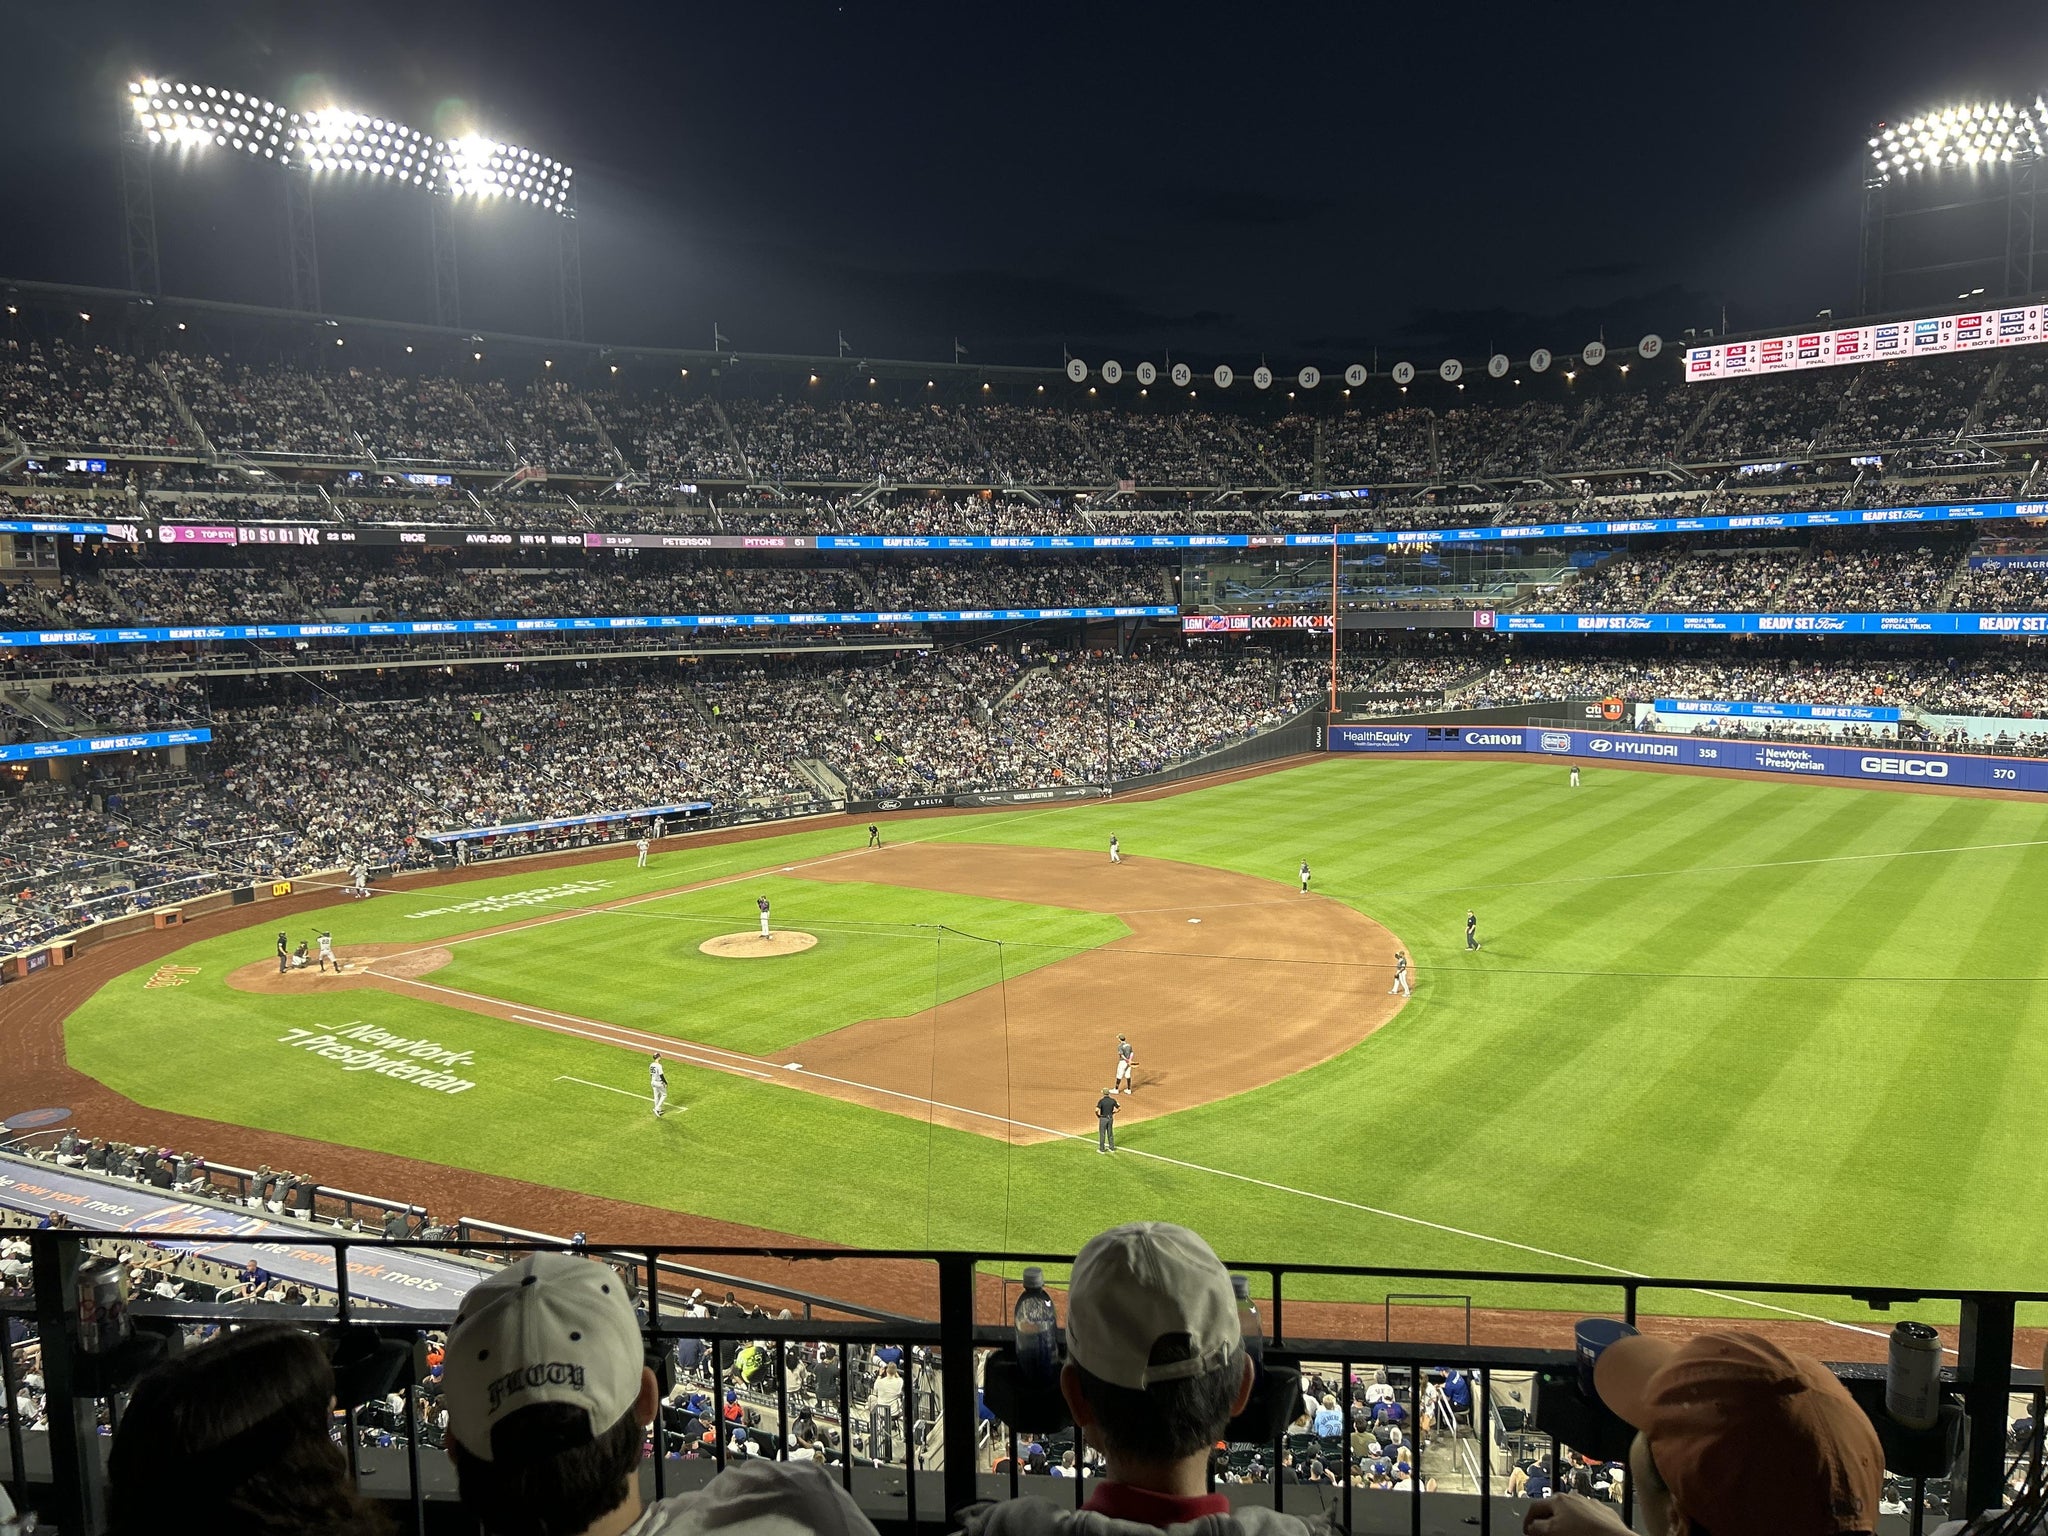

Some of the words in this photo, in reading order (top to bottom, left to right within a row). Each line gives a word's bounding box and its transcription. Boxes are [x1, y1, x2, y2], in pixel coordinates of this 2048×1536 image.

[1960, 317, 1979, 326] CIN
[2002, 312, 2023, 321] TEX
[1917, 323, 1937, 332] MIA
[1941, 321, 1952, 329] 10
[2000, 325, 2023, 334] HOU
[2029, 323, 2036, 331] 4
[1877, 328, 1898, 337] TOR
[1958, 330, 1980, 339] CLE
[1986, 328, 1992, 336] 6
[1876, 340, 1898, 349] DET
[1920, 335, 1934, 343] TB
[1642, 341, 1657, 353] 42
[1585, 348, 1603, 359] SHEA
[1727, 358, 1746, 366] COL
[1074, 366, 1081, 377] 5
[1107, 367, 1117, 378] 18
[1142, 368, 1151, 379] 16
[1175, 370, 1187, 380] 24
[1350, 370, 1361, 381] 41
[1398, 367, 1409, 378] 14
[1444, 365, 1458, 376] 37
[1219, 371, 1227, 382] 17
[1257, 373, 1268, 383] 36
[1304, 372, 1314, 383] 31
[1863, 511, 1887, 521] READY
[1888, 510, 1902, 519] SET
[1902, 509, 1925, 519] Ford
[2016, 505, 2044, 515] READY
[145, 529, 152, 539] 1
[185, 530, 195, 538] 3
[400, 533, 426, 542] RICE
[466, 534, 488, 543] AVG
[488, 535, 512, 544] .309
[520, 535, 534, 544] HR
[535, 536, 546, 544] 14
[567, 536, 582, 544] 30
[663, 537, 712, 546] PETERSON
[745, 538, 785, 546] PITCHES
[1184, 618, 1202, 630] LGM
[1231, 618, 1248, 629] LGM
[1480, 613, 1490, 625] 8
[1578, 618, 1609, 628] READY
[1610, 618, 1625, 628] SET
[1626, 618, 1651, 628] Ford
[1759, 618, 1793, 629] READY
[1795, 618, 1814, 629] SET
[1815, 618, 1845, 629] Ford
[1980, 618, 2019, 630] READY
[2022, 618, 2045, 630] SET
[40, 634, 63, 642] READY
[64, 633, 77, 641] SET
[77, 633, 98, 641] Ford
[1610, 704, 1620, 713] 21
[1677, 702, 1699, 711] READY
[1699, 703, 1712, 712] SET
[1711, 704, 1731, 713] Ford
[1811, 708, 1837, 717] READY
[1837, 709, 1851, 718] SET
[1851, 710, 1875, 719] Ford
[1343, 731, 1410, 743] HealthEquity
[1465, 732, 1522, 745] Canon
[91, 740, 114, 750] READY
[115, 738, 129, 747] SET
[129, 738, 147, 746] Ford
[1615, 742, 1678, 757] HYUNDAI
[1699, 748, 1717, 758] 358
[1765, 749, 1812, 760] NewYork-
[1765, 757, 1824, 771] Presbyterian
[1861, 757, 1949, 778] GEICO
[1993, 769, 2016, 780] 370
[920, 798, 943, 806] DELTA
[337, 1023, 477, 1066] NewYork-
[306, 1034, 477, 1095] Presbyterian
[10, 1182, 47, 1201] new
[47, 1189, 91, 1207] york
[83, 1197, 134, 1218] mets
[287, 1248, 336, 1266] new
[381, 1268, 444, 1292] mets
